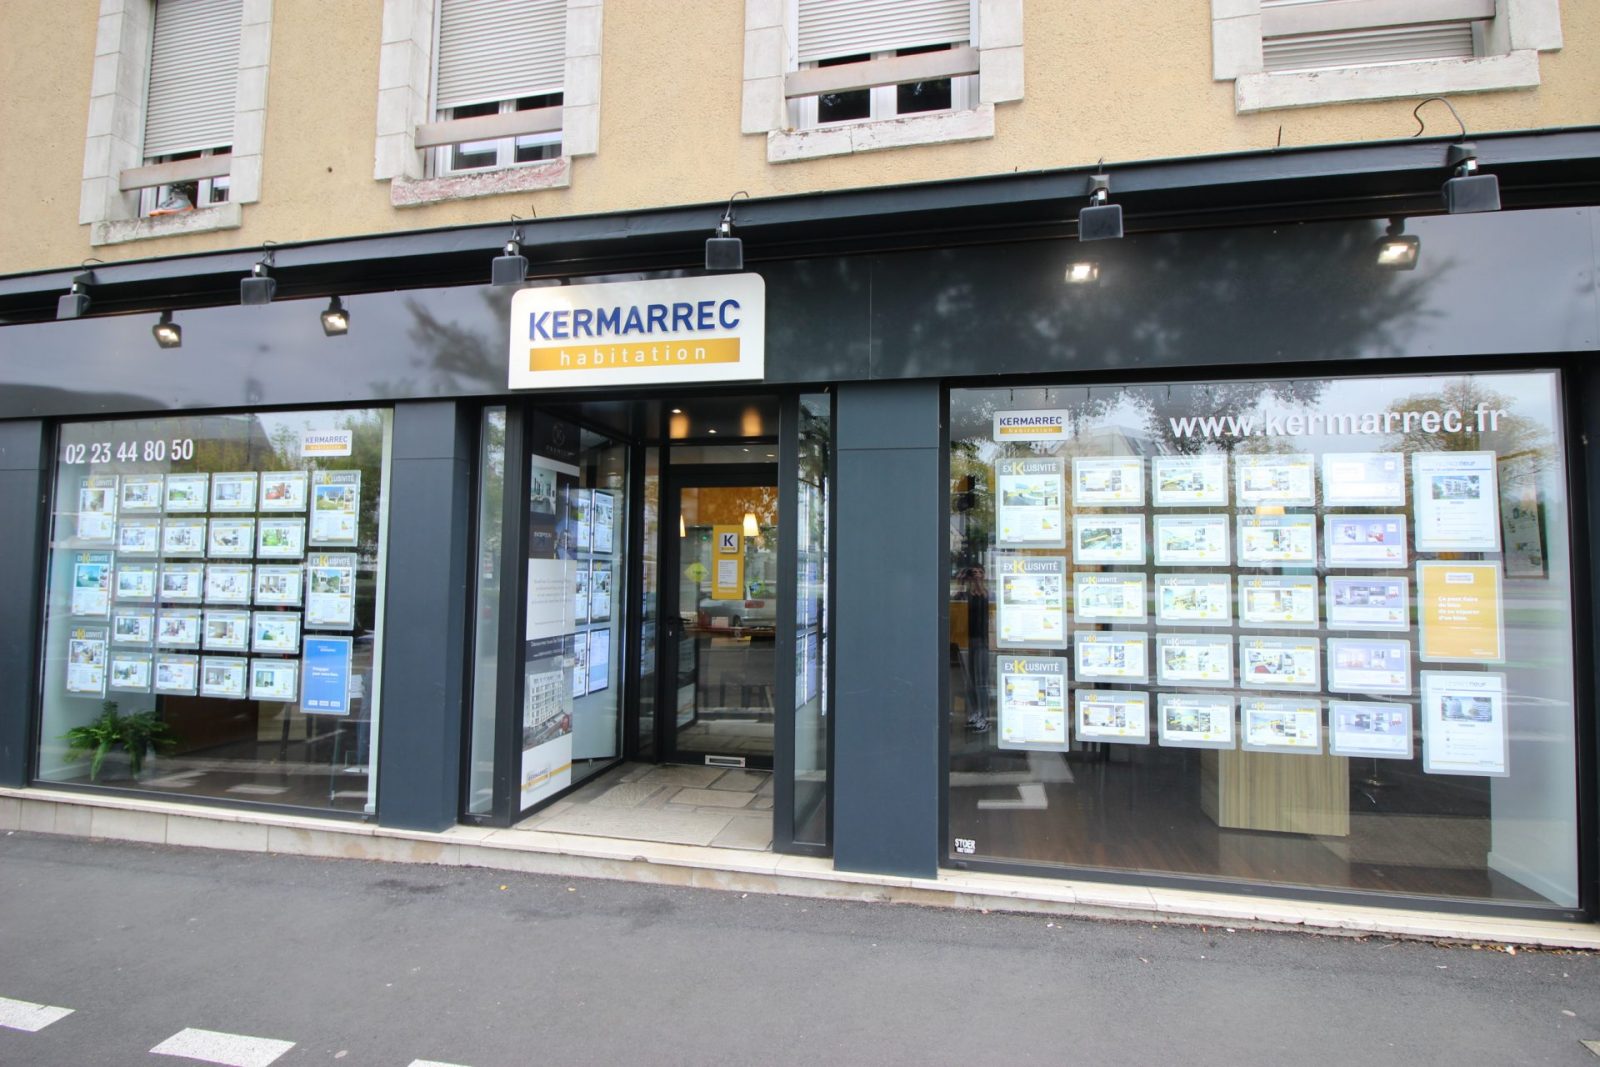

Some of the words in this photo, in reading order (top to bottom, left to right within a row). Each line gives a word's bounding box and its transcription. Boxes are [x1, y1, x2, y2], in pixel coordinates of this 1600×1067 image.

[529, 299, 740, 340] KERMARREC
[560, 345, 706, 367] habitation
[1000, 416, 1062, 426] KERMARREC
[1169, 402, 1507, 438] www.kermarrec.fr
[305, 435, 348, 444] KERMARREC
[65, 443, 86, 464] 02
[90, 442, 112, 463] 23
[117, 441, 138, 462] 44
[143, 440, 165, 461] 80
[171, 438, 193, 460] 50
[724, 535, 734, 546] K
